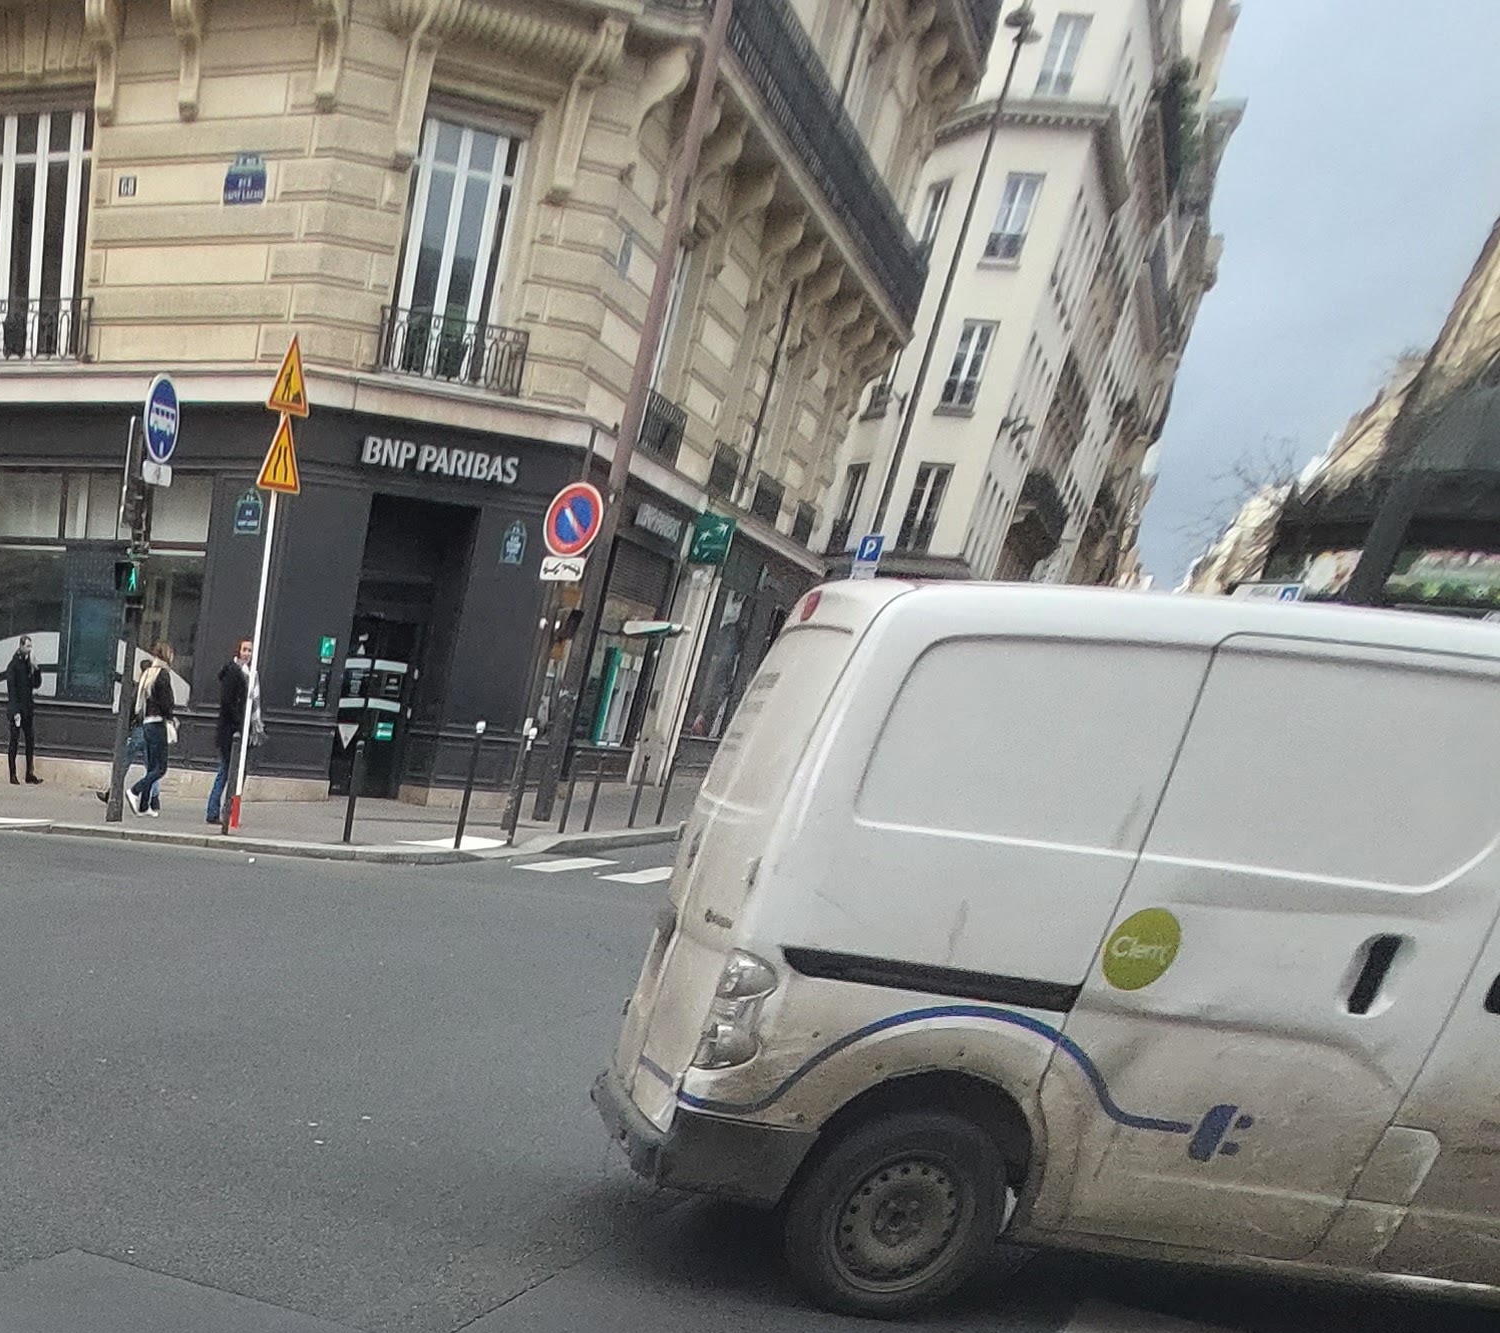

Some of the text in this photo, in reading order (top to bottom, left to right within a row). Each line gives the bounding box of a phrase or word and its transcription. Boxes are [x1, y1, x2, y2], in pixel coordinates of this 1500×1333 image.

[361, 435, 519, 484] BNP PARIBAS
[862, 540, 876, 558] P
